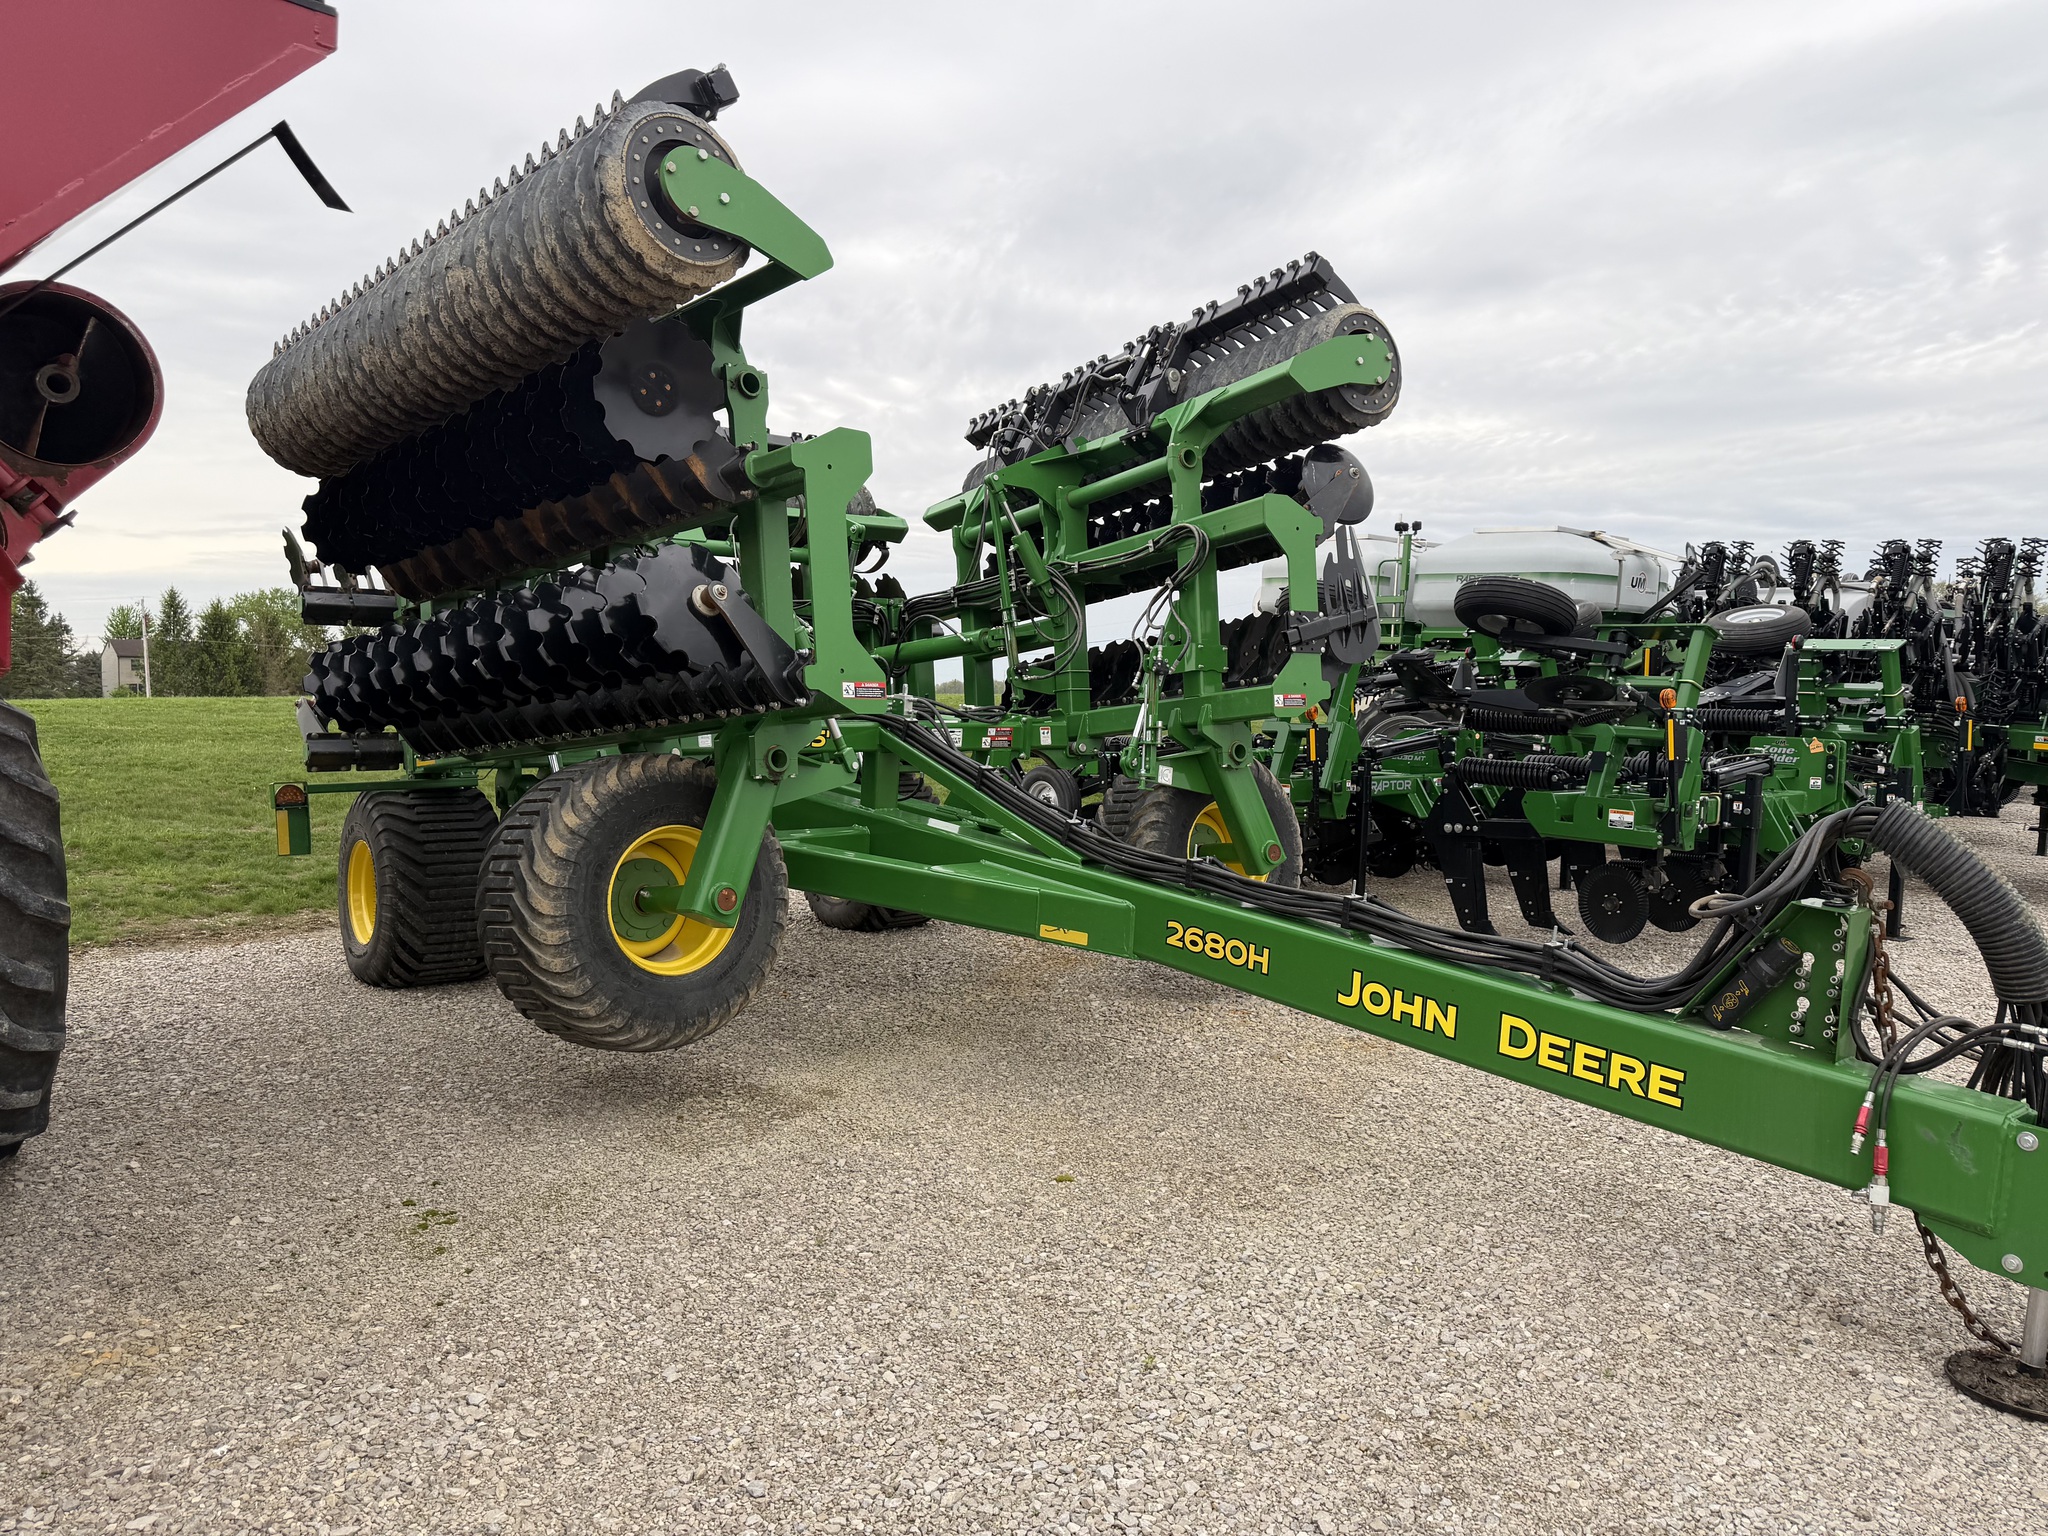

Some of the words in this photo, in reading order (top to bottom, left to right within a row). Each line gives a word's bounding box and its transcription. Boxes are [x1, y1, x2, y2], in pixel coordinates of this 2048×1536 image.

[1371, 780, 1412, 793] RAPTOR
[1166, 920, 1270, 976] 2680H
[1336, 969, 1459, 1040] JOHN
[1497, 1011, 1688, 1110] DEERE
